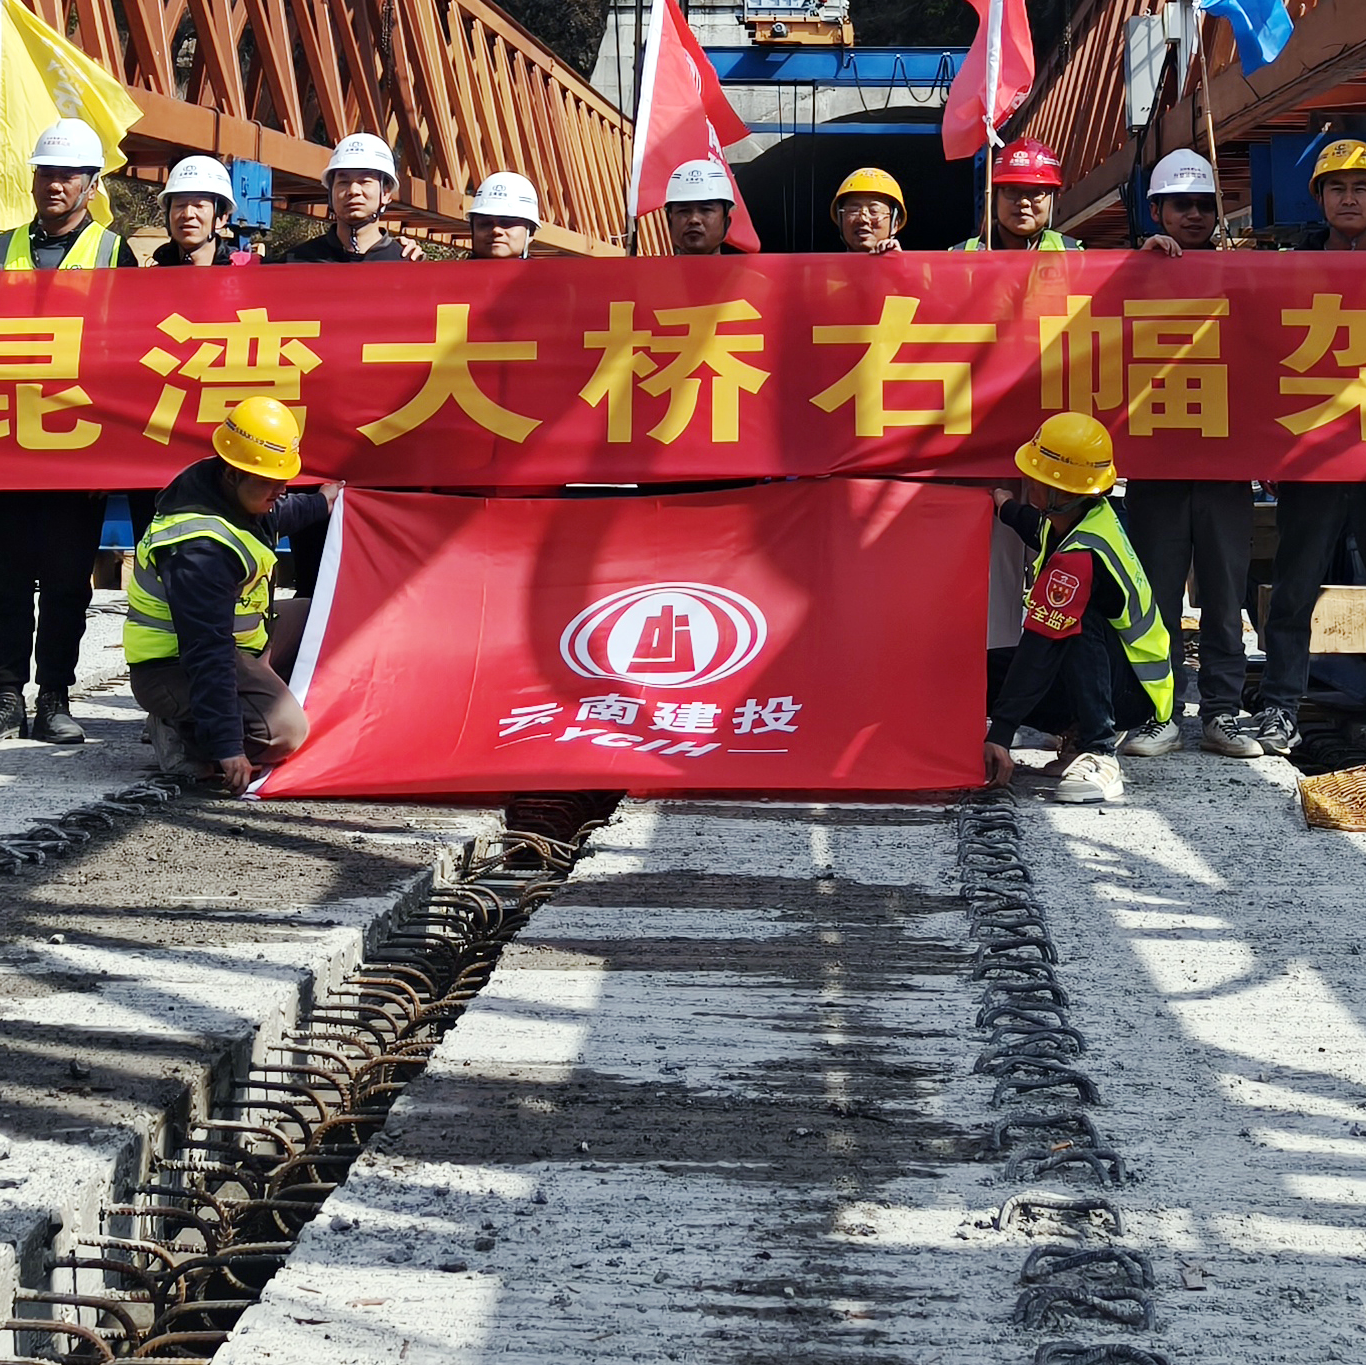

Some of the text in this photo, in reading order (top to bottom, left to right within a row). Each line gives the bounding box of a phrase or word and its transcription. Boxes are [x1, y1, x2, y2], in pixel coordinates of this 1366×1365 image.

[499, 694, 803, 737] 云南建投
[555, 727, 722, 757] YCIH
